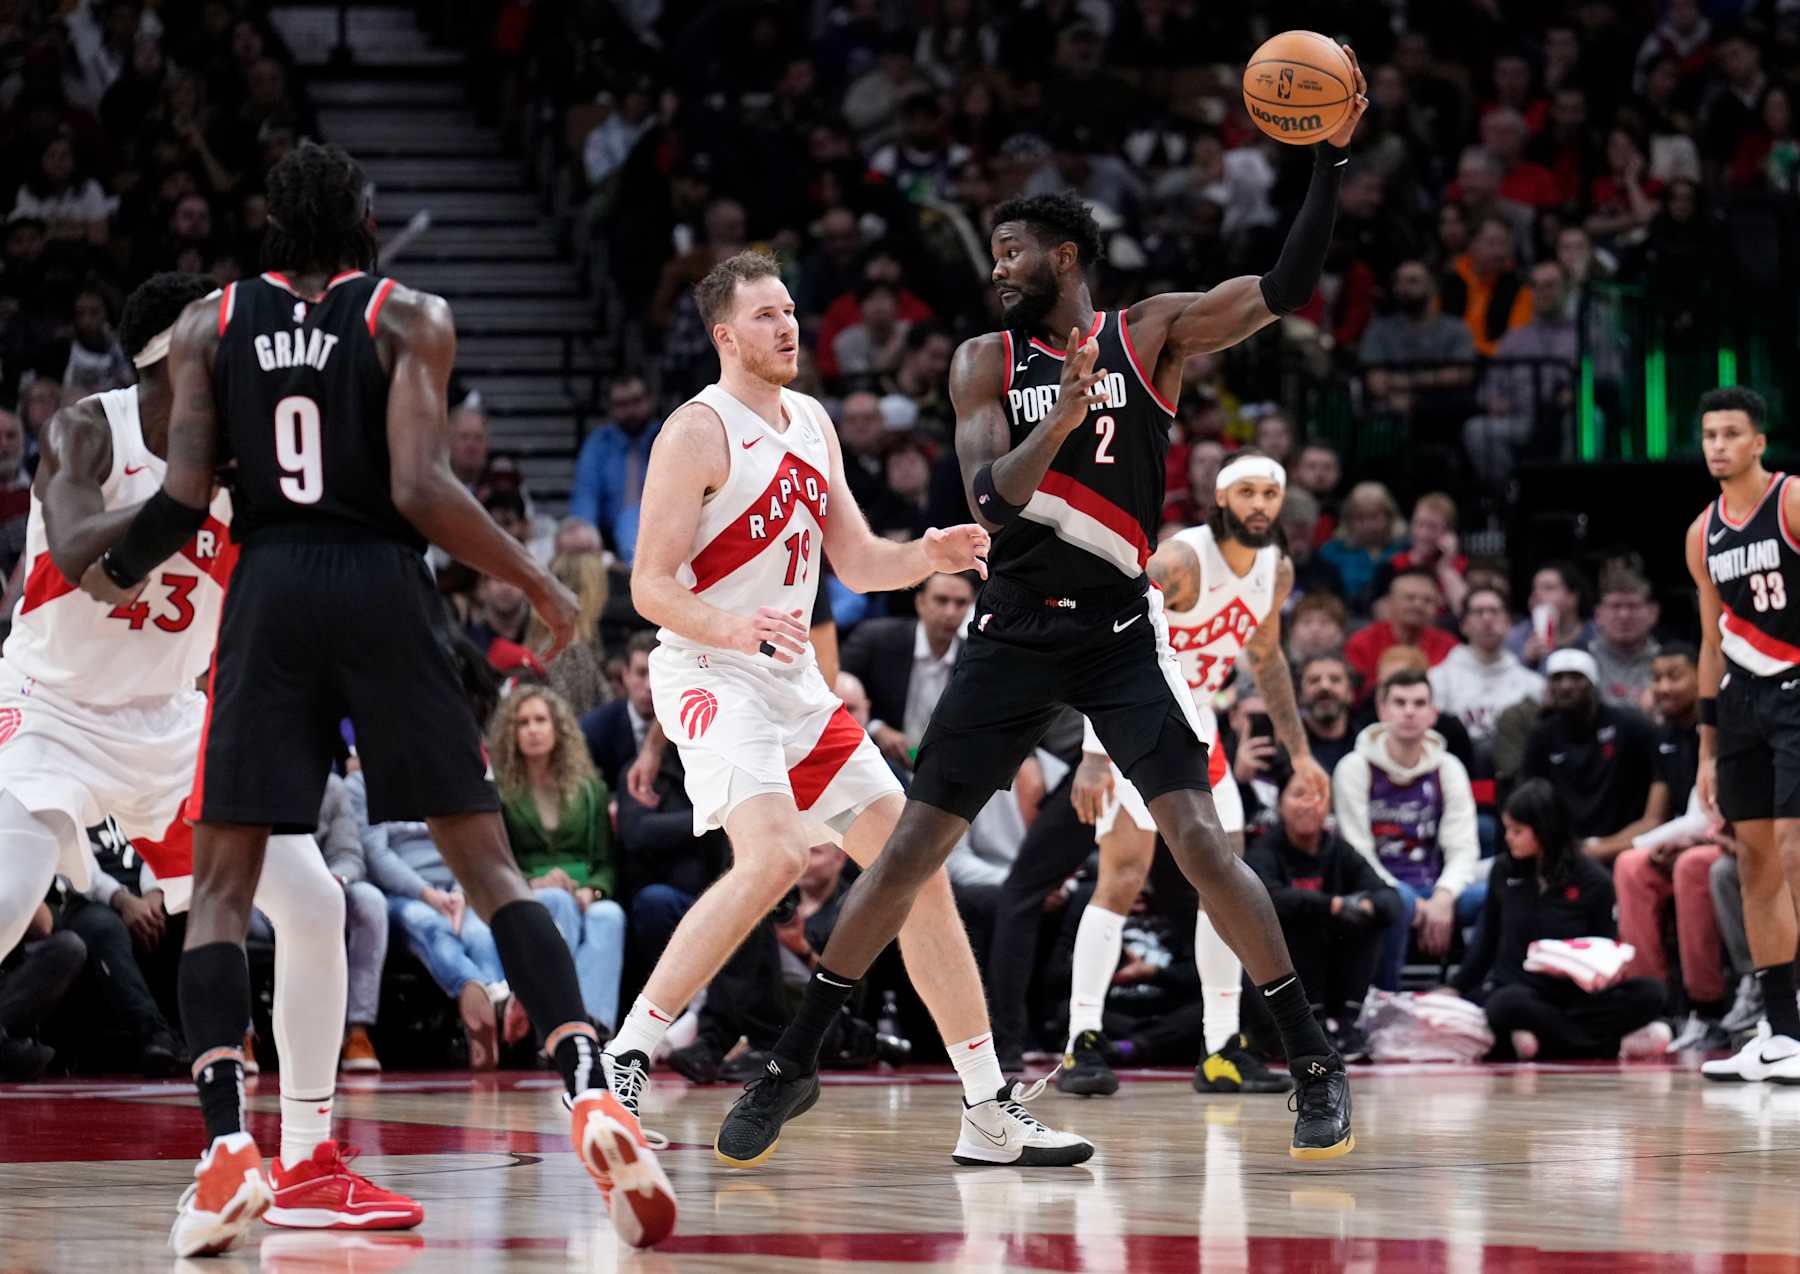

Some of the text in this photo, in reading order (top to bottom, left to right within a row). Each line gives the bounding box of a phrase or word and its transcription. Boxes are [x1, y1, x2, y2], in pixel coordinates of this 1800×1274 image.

[1251, 103, 1322, 132] Wilson
[254, 327, 339, 372] GRANT
[1007, 372, 1127, 426] PORTND
[274, 395, 324, 505] 9
[1094, 415, 1116, 465] 2
[784, 528, 810, 587] 19
[1708, 538, 1781, 586] PORTLAND
[107, 572, 199, 633] 43
[1749, 570, 1787, 613] 33
